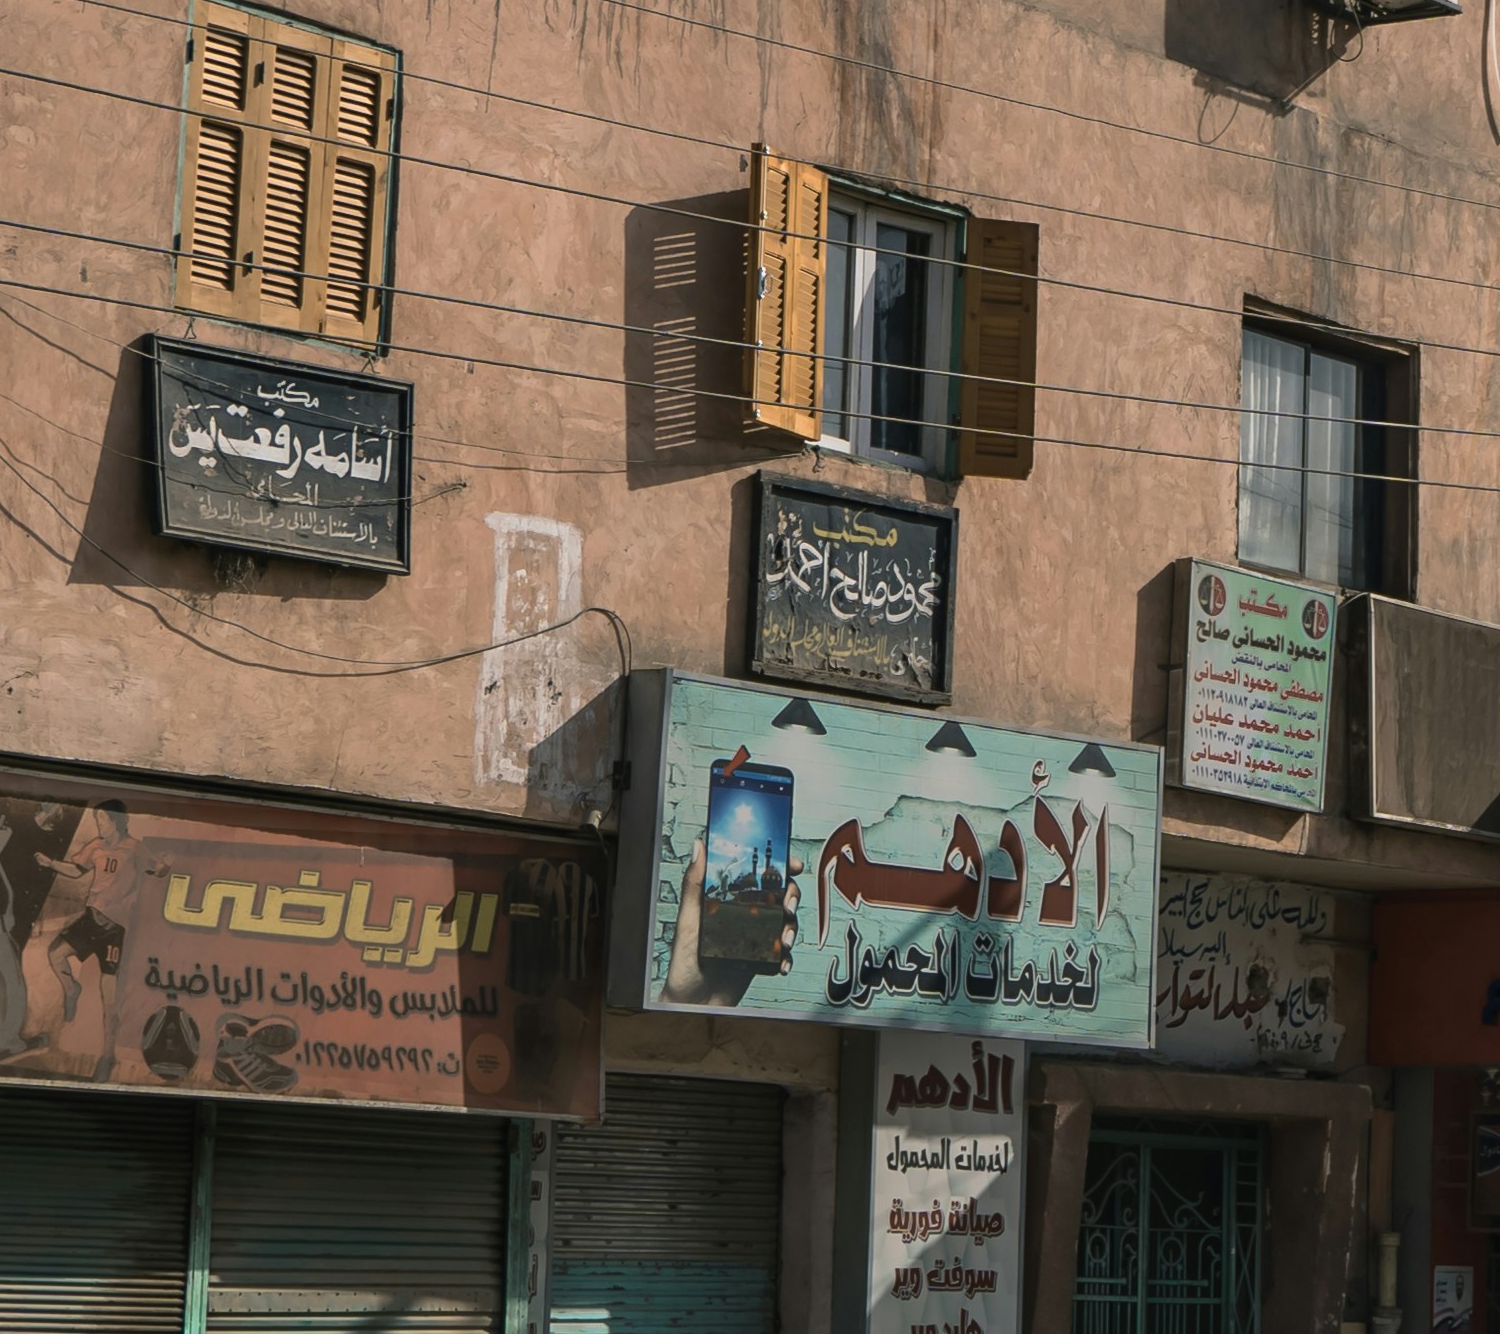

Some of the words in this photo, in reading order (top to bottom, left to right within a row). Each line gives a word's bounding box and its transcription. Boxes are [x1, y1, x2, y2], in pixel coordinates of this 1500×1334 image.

[256, 379, 320, 409] مكتب
[812, 508, 899, 550] مكتب
[1237, 588, 1288, 619] مكتب
[1196, 619, 1230, 643] صالح
[1286, 640, 1327, 663] محمود
[1243, 672, 1278, 694] محمود
[104, 857, 118, 874] 10
[817, 759, 1110, 951] الأدهم
[144, 957, 265, 1005] الرياضية
[824, 919, 962, 1009] المحمول
[964, 932, 1101, 1010] لخدمات
[270, 971, 383, 1015] والأدوات
[388, 984, 499, 1023] للملابس
[886, 1039, 1015, 1116] الأدهم
[886, 1134, 952, 1174] المحمول
[954, 1139, 1010, 1175] لخدمات
[888, 1198, 944, 1243] فورية
[948, 1197, 1006, 1246] صيانة
[926, 1255, 999, 1299] سوفت
